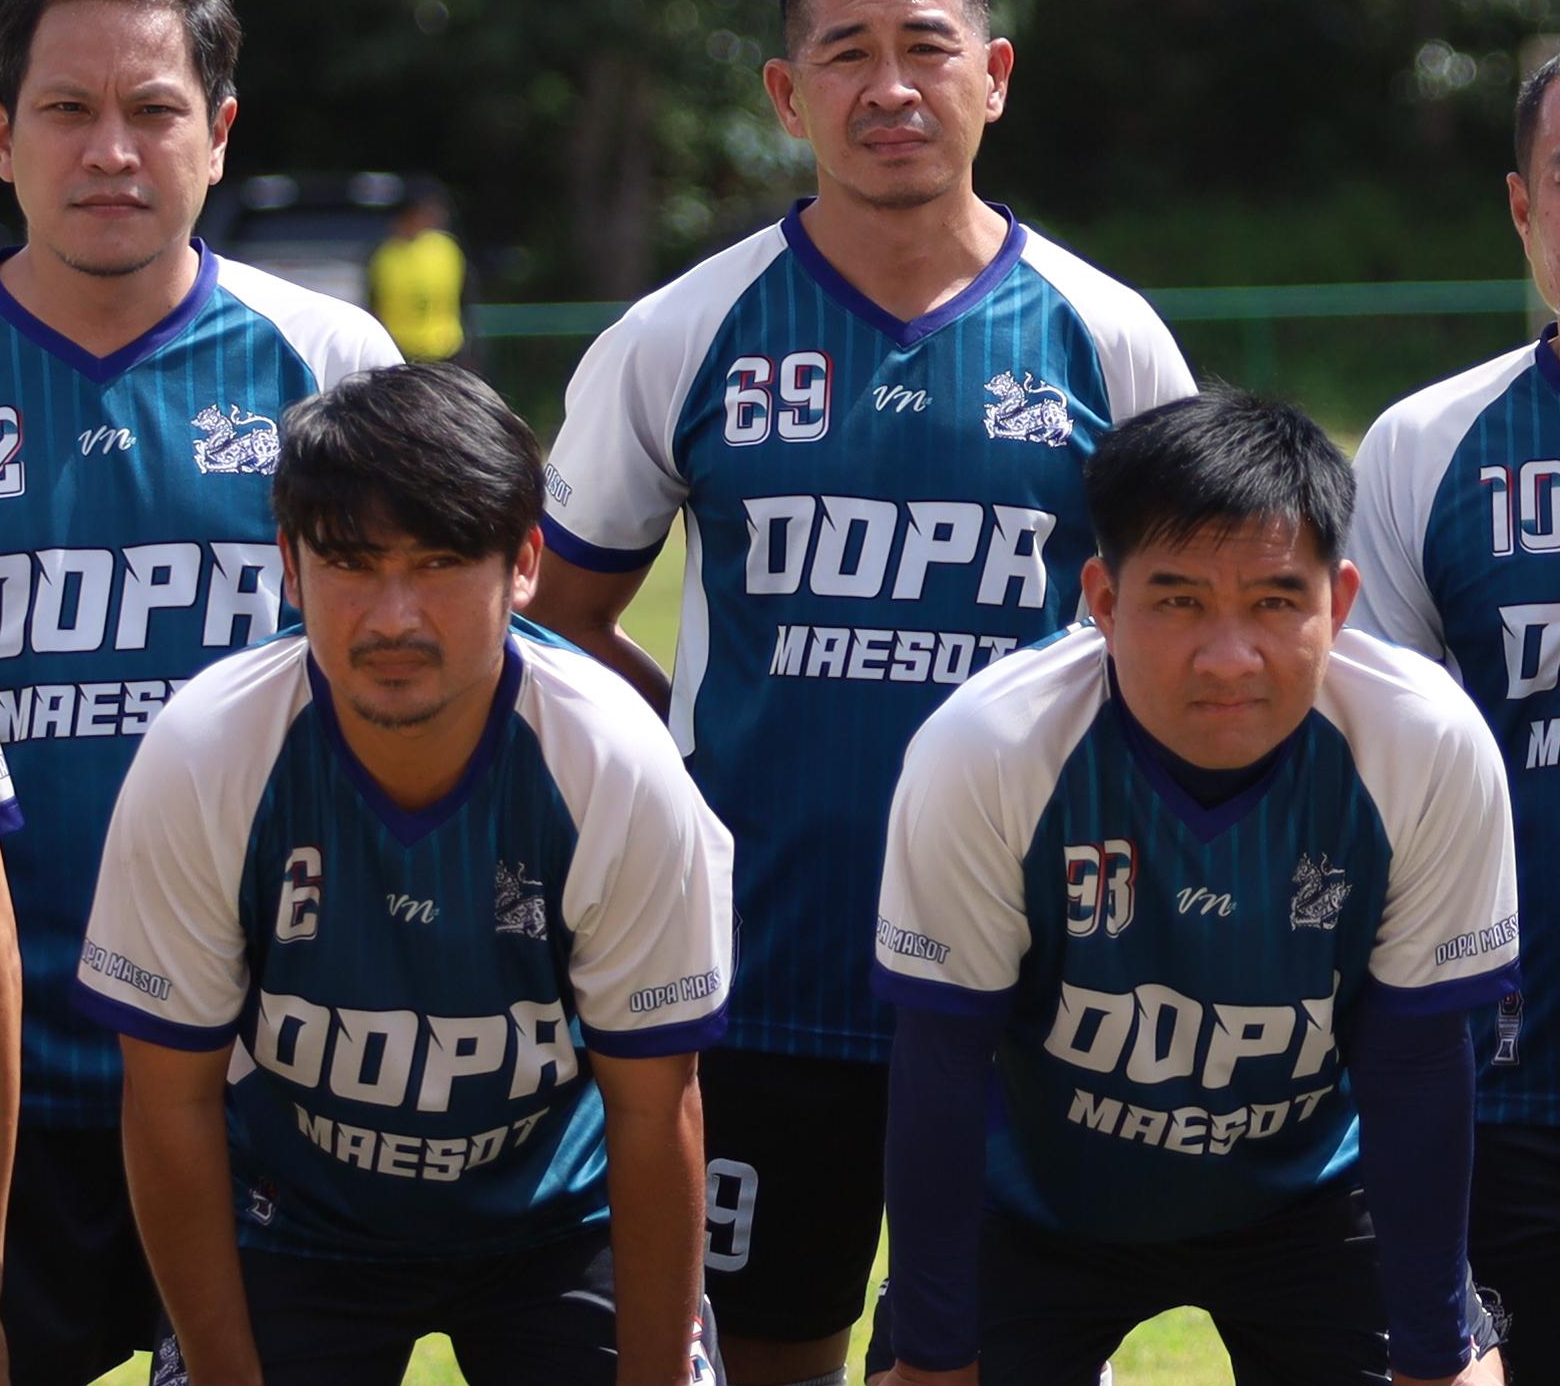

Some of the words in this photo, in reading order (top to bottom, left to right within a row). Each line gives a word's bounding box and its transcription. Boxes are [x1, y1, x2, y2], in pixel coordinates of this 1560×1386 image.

[722, 350, 833, 448] 69
[743, 495, 1057, 608] DOPA
[276, 845, 325, 944] 6
[106, 952, 172, 1001] MAESOT
[252, 991, 579, 1112] DOPA
[293, 1102, 551, 1182] MAESOT
[1067, 1084, 1333, 1155] MAESOT
